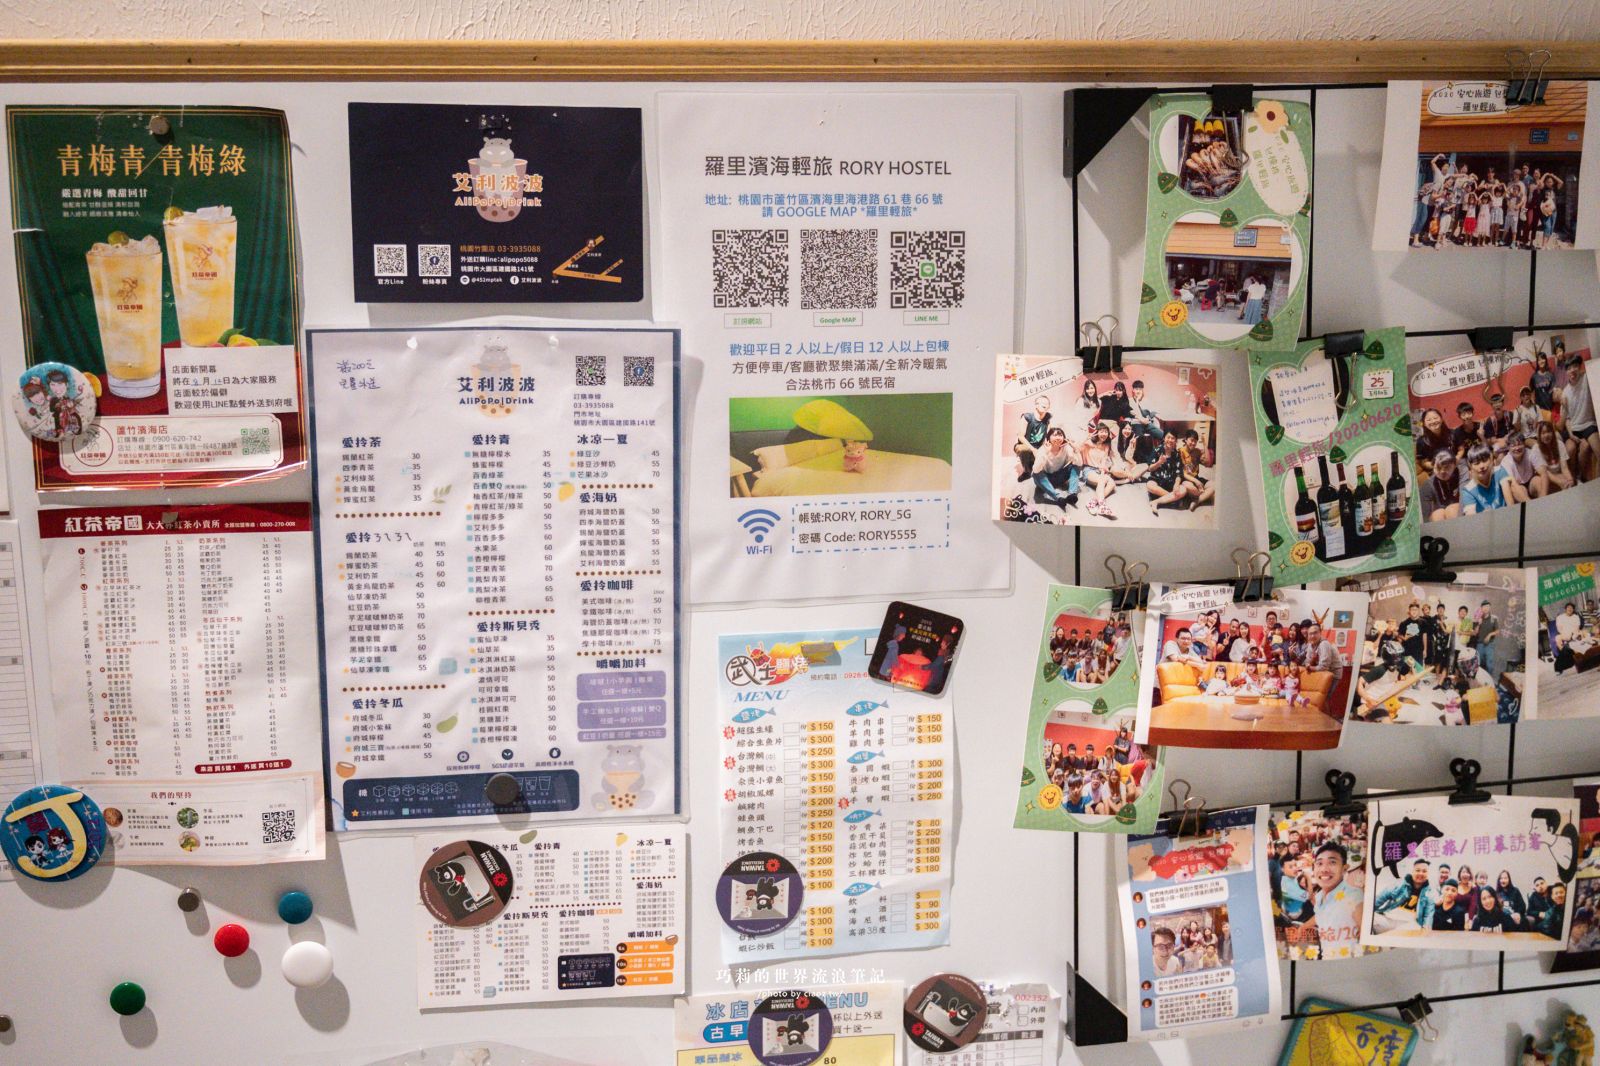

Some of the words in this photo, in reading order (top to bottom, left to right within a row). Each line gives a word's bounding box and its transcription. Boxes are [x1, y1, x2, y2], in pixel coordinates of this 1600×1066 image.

[704, 156, 832, 176] 羅里濱海輕旅
[840, 161, 882, 176] RORY
[889, 161, 951, 176] HOSTEL
[452, 173, 543, 193] 艾利波波
[884, 194, 897, 205] 61
[901, 194, 912, 205] 巷
[915, 194, 929, 204] 66
[932, 194, 943, 205] 號
[762, 206, 773, 218] 請
[777, 206, 826, 217] GOOGLE
[830, 206, 856, 217] MAP
[820, 316, 840, 324] Google
[730, 344, 780, 356] 歡迎平日
[785, 344, 792, 354] 2
[796, 342, 864, 355] 人以上/假日
[869, 342, 884, 352] 12
[888, 340, 950, 352] 人以上包棟
[458, 377, 535, 392] 艾利波波
[786, 378, 836, 391] 合法桃市
[840, 378, 855, 389] 66
[858, 376, 896, 389] 號民宿
[1370, 378, 1384, 388] 25
[342, 437, 381, 448] 愛拎茶
[580, 492, 617, 503] 愛海奶
[860, 510, 912, 522] RORY_5G
[64, 514, 143, 533] 紅茶帝國
[799, 532, 820, 544] 密碼
[824, 532, 856, 543] Code:
[858, 530, 916, 542] RORY5555
[746, 546, 773, 555] Wi-Fi
[580, 580, 633, 591] 愛拎咖啡
[735, 690, 789, 702] MENU
[352, 698, 403, 709] 愛拎冬瓜
[480, 852, 496, 875] TAIWAN
